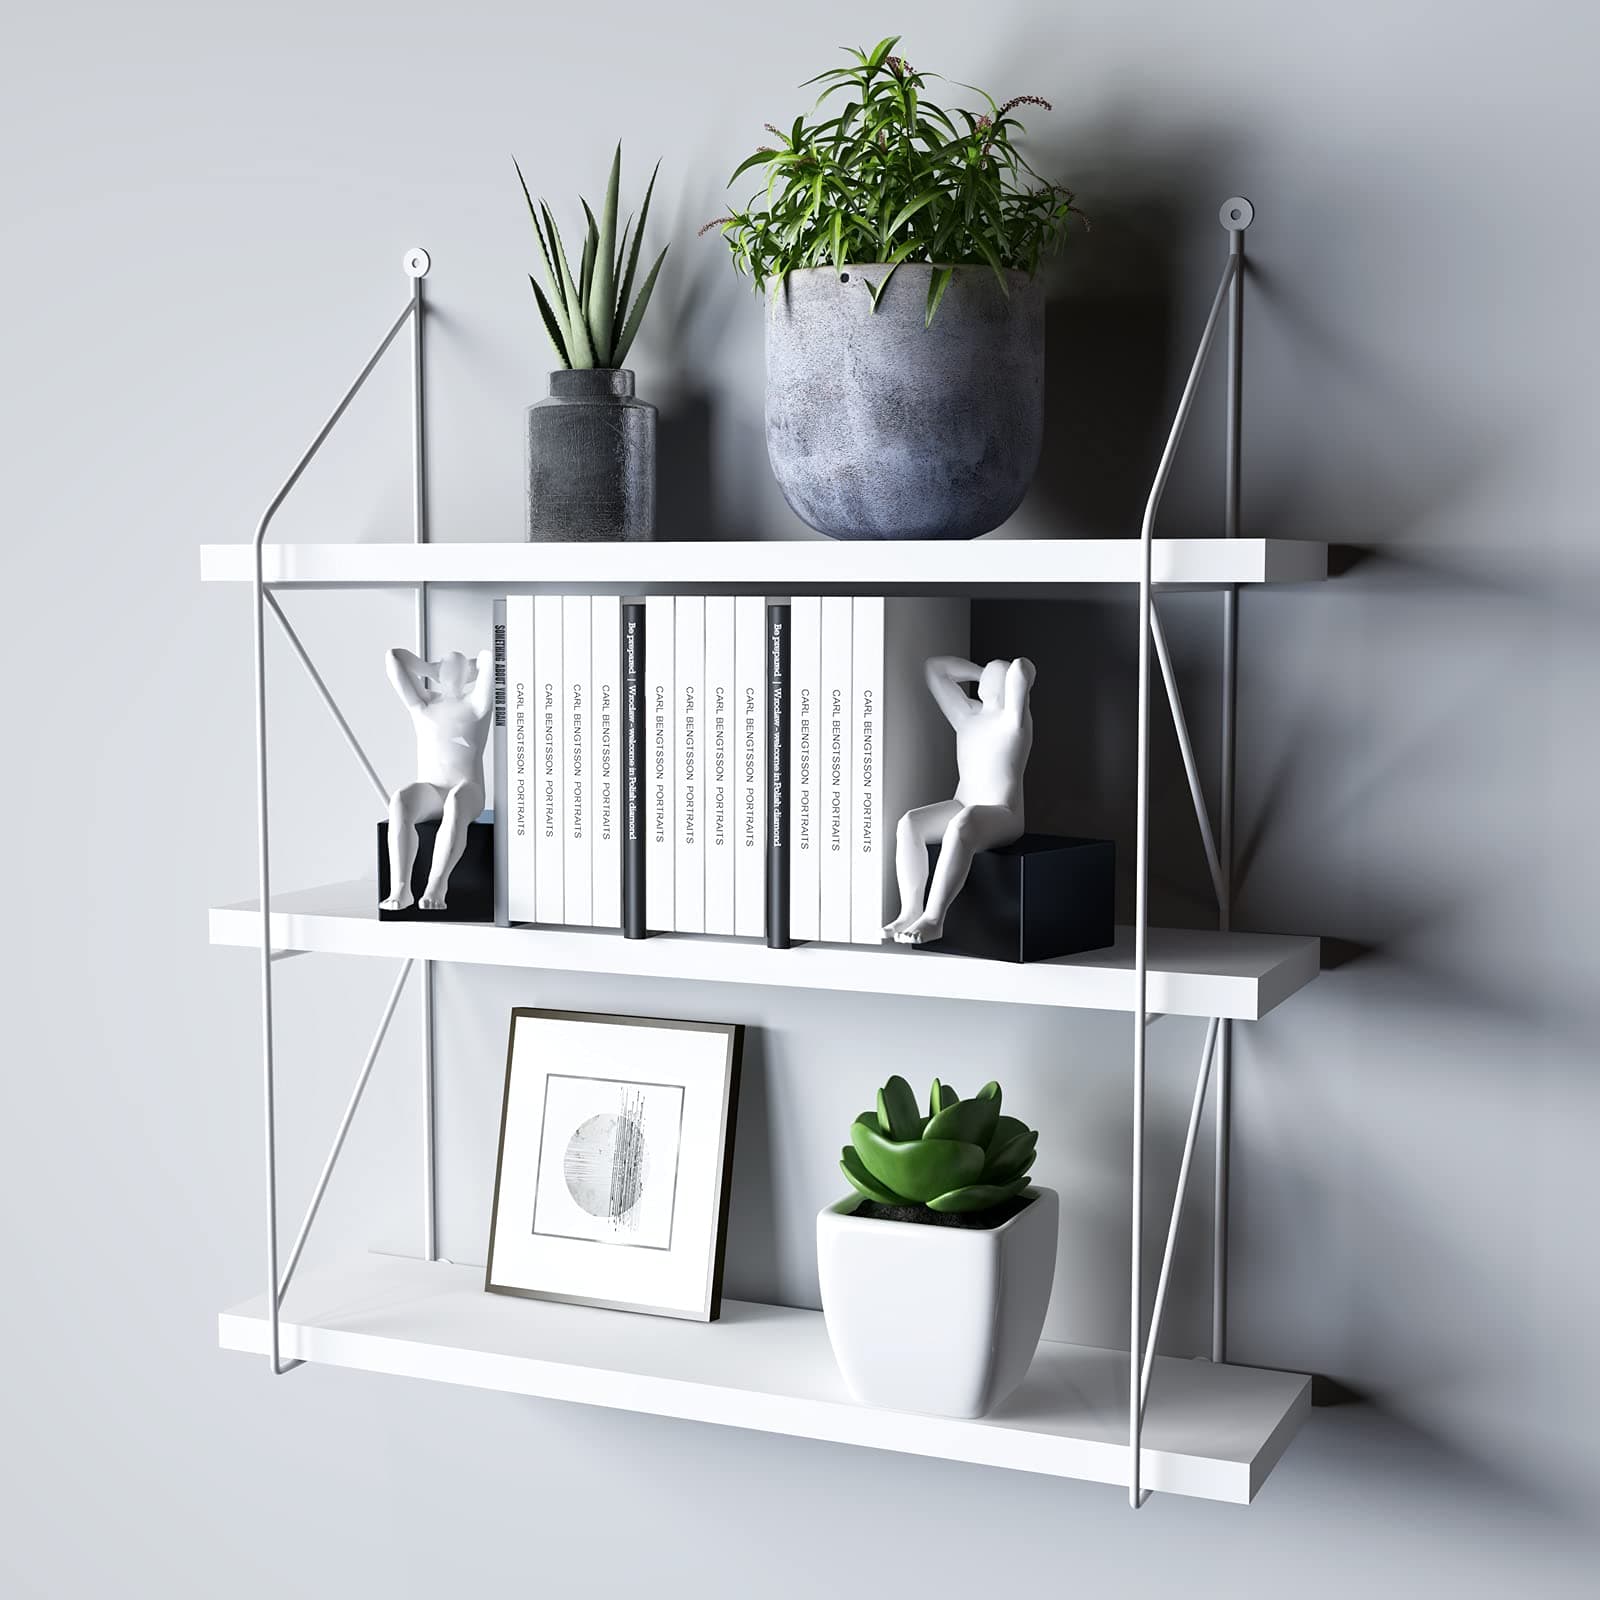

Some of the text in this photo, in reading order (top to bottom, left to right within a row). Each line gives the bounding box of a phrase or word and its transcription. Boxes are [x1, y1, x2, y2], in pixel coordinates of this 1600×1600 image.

[495, 625, 505, 727] SOMETHING ABOUT YOUR BRAIN
[627, 634, 637, 674] prepared
[772, 636, 782, 677] prepared
[516, 682, 525, 836] CARL BENGTSSON PORTRAITS
[545, 683, 554, 838] CARL BENGTSSON PORTRAITS
[574, 684, 582, 839] CARL BENGTSSON PORTRAITS
[603, 685, 611, 840] CARL BENGTSSON PORTRAITS
[628, 728, 637, 766] welcome
[628, 767, 637, 776] in
[628, 777, 637, 801] Polish
[656, 686, 665, 843] CARL BENGTSSON PORTRAITS
[686, 687, 695, 844] CARL BENGTSSON PORTRAITS
[716, 687, 725, 846] CARL BENGTSSON PORTRAITS
[746, 688, 755, 847] CARL BENGTSSON PORTRAITS
[774, 732, 782, 771] welcome
[774, 772, 782, 781] in
[774, 782, 782, 807] Polish
[801, 689, 810, 850] CARL BENGTSSON PORTRAITS
[832, 689, 841, 852] CARL BENGTSSON PORTRAITS
[863, 690, 872, 853] CARL BENGTSSON PORTRAITS
[628, 802, 637, 840] diamond
[774, 808, 782, 847] diamond
